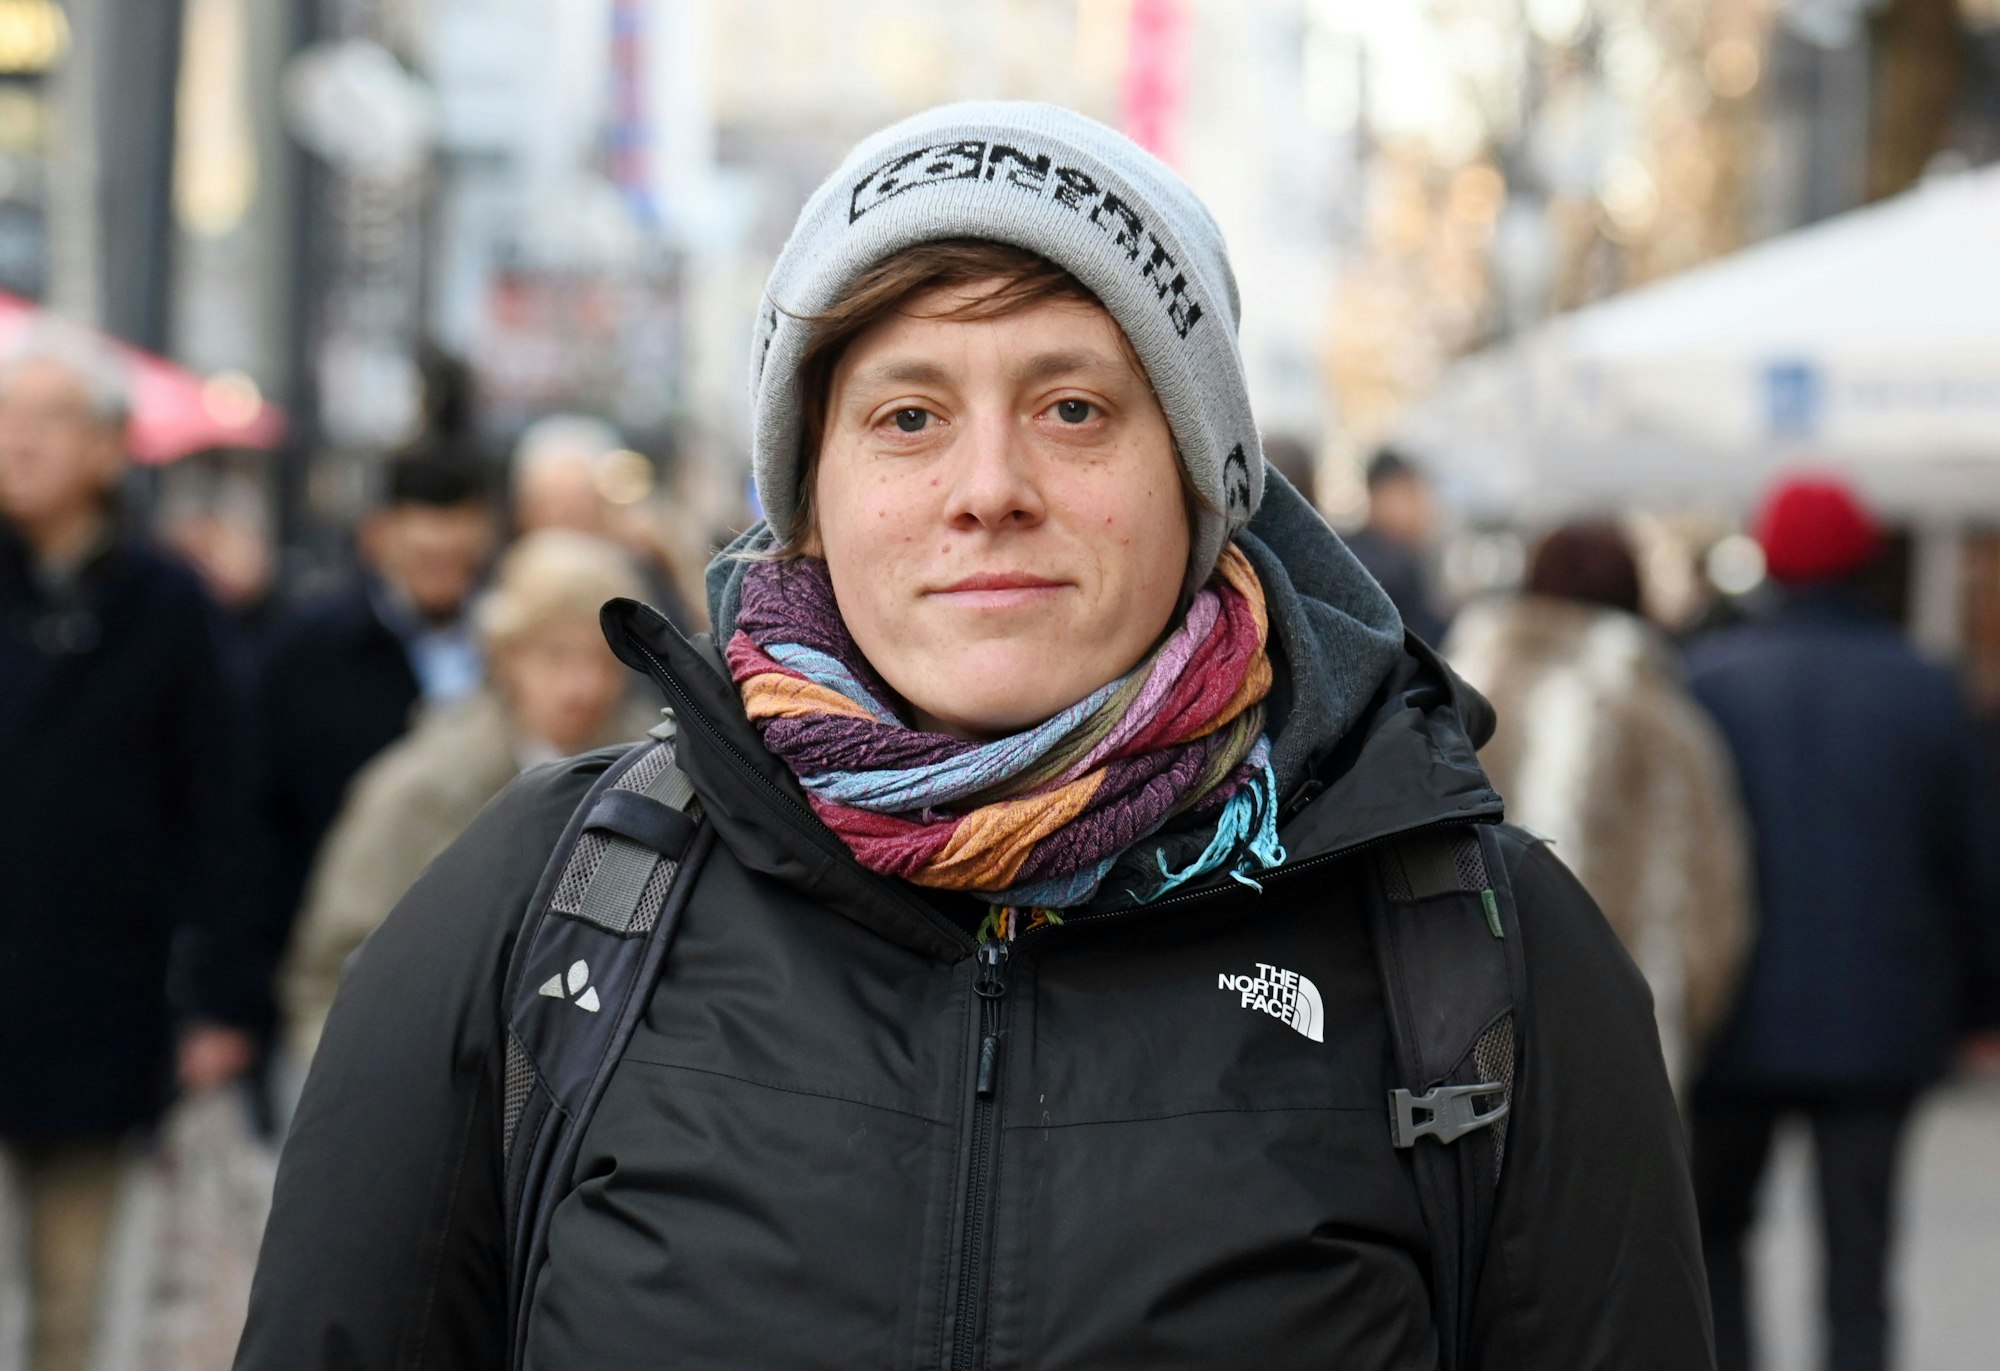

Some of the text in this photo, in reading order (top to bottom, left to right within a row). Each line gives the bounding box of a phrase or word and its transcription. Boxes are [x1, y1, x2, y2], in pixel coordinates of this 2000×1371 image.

[1218, 974, 1298, 1008] NORTH
[1256, 963, 1299, 990] THE
[1241, 992, 1294, 1026] FACE
